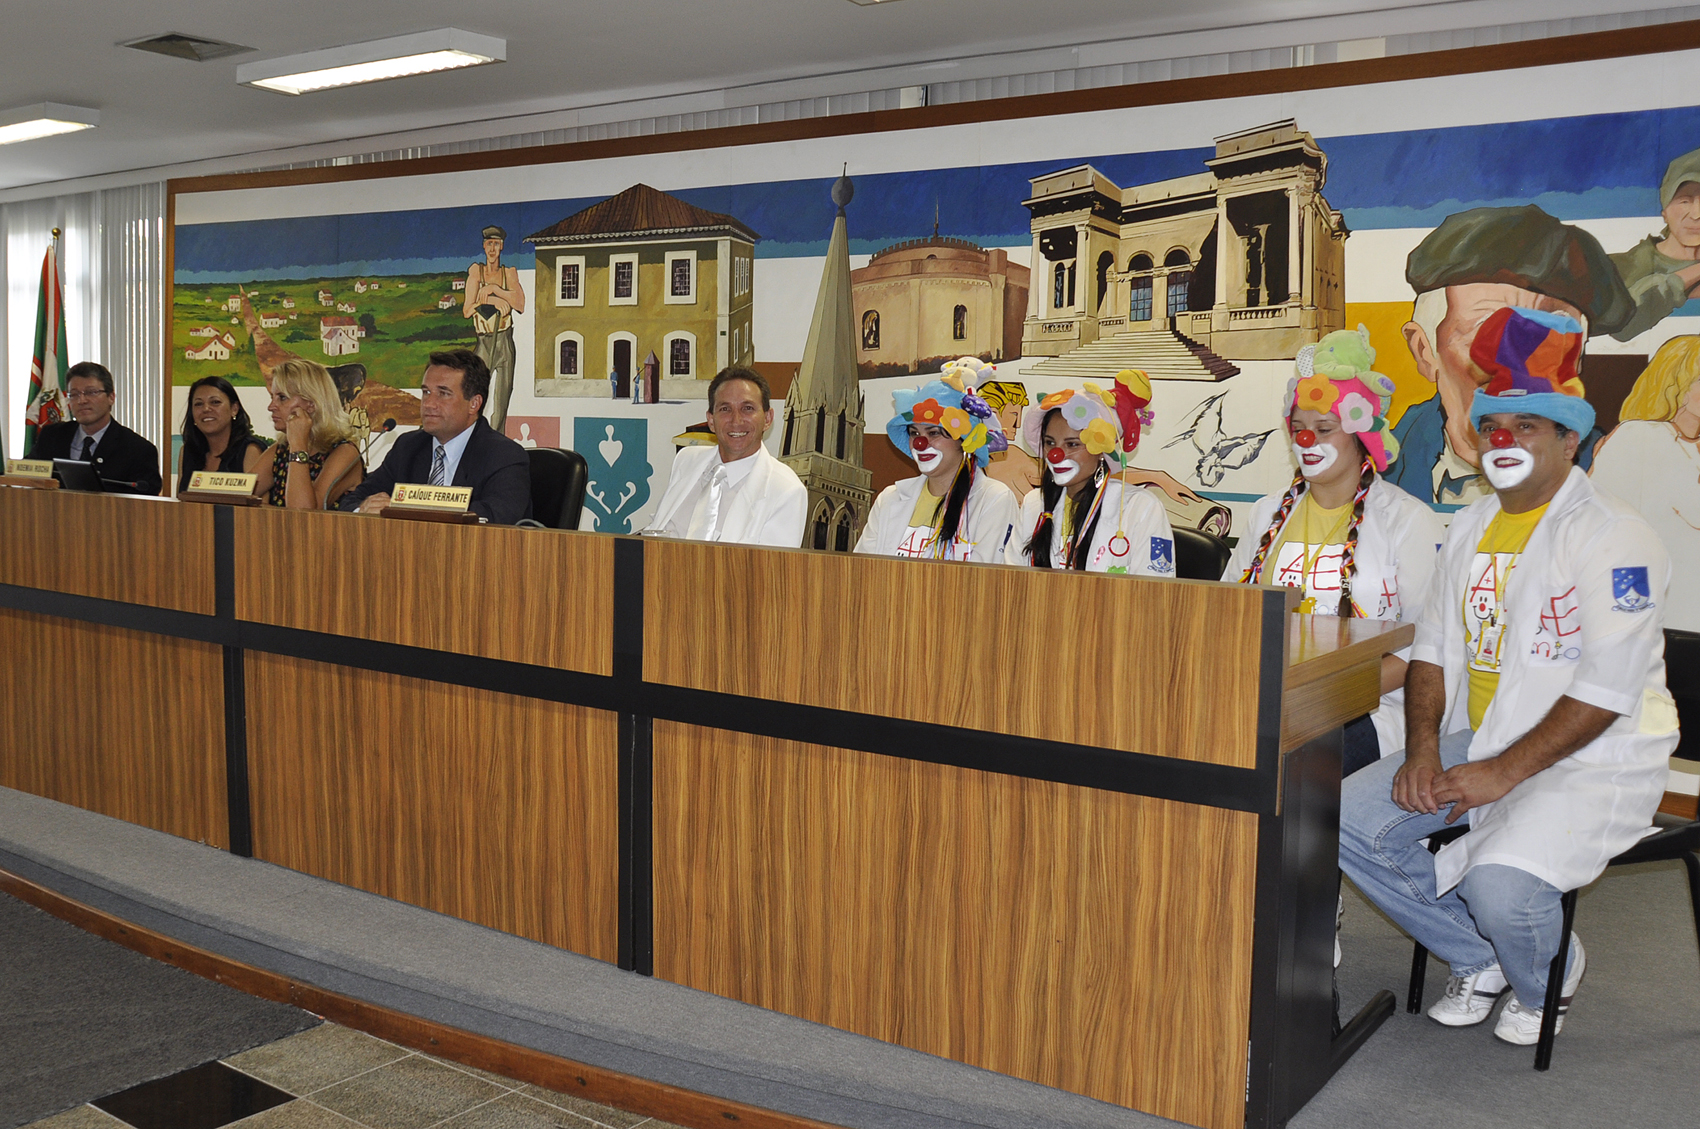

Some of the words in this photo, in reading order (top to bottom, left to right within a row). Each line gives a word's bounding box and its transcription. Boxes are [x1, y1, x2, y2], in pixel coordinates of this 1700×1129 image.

[209, 477, 224, 486] TICO
[225, 478, 247, 487] KUZMA
[408, 488, 432, 501] CAÍQUE
[433, 491, 468, 503] FERRANTE
